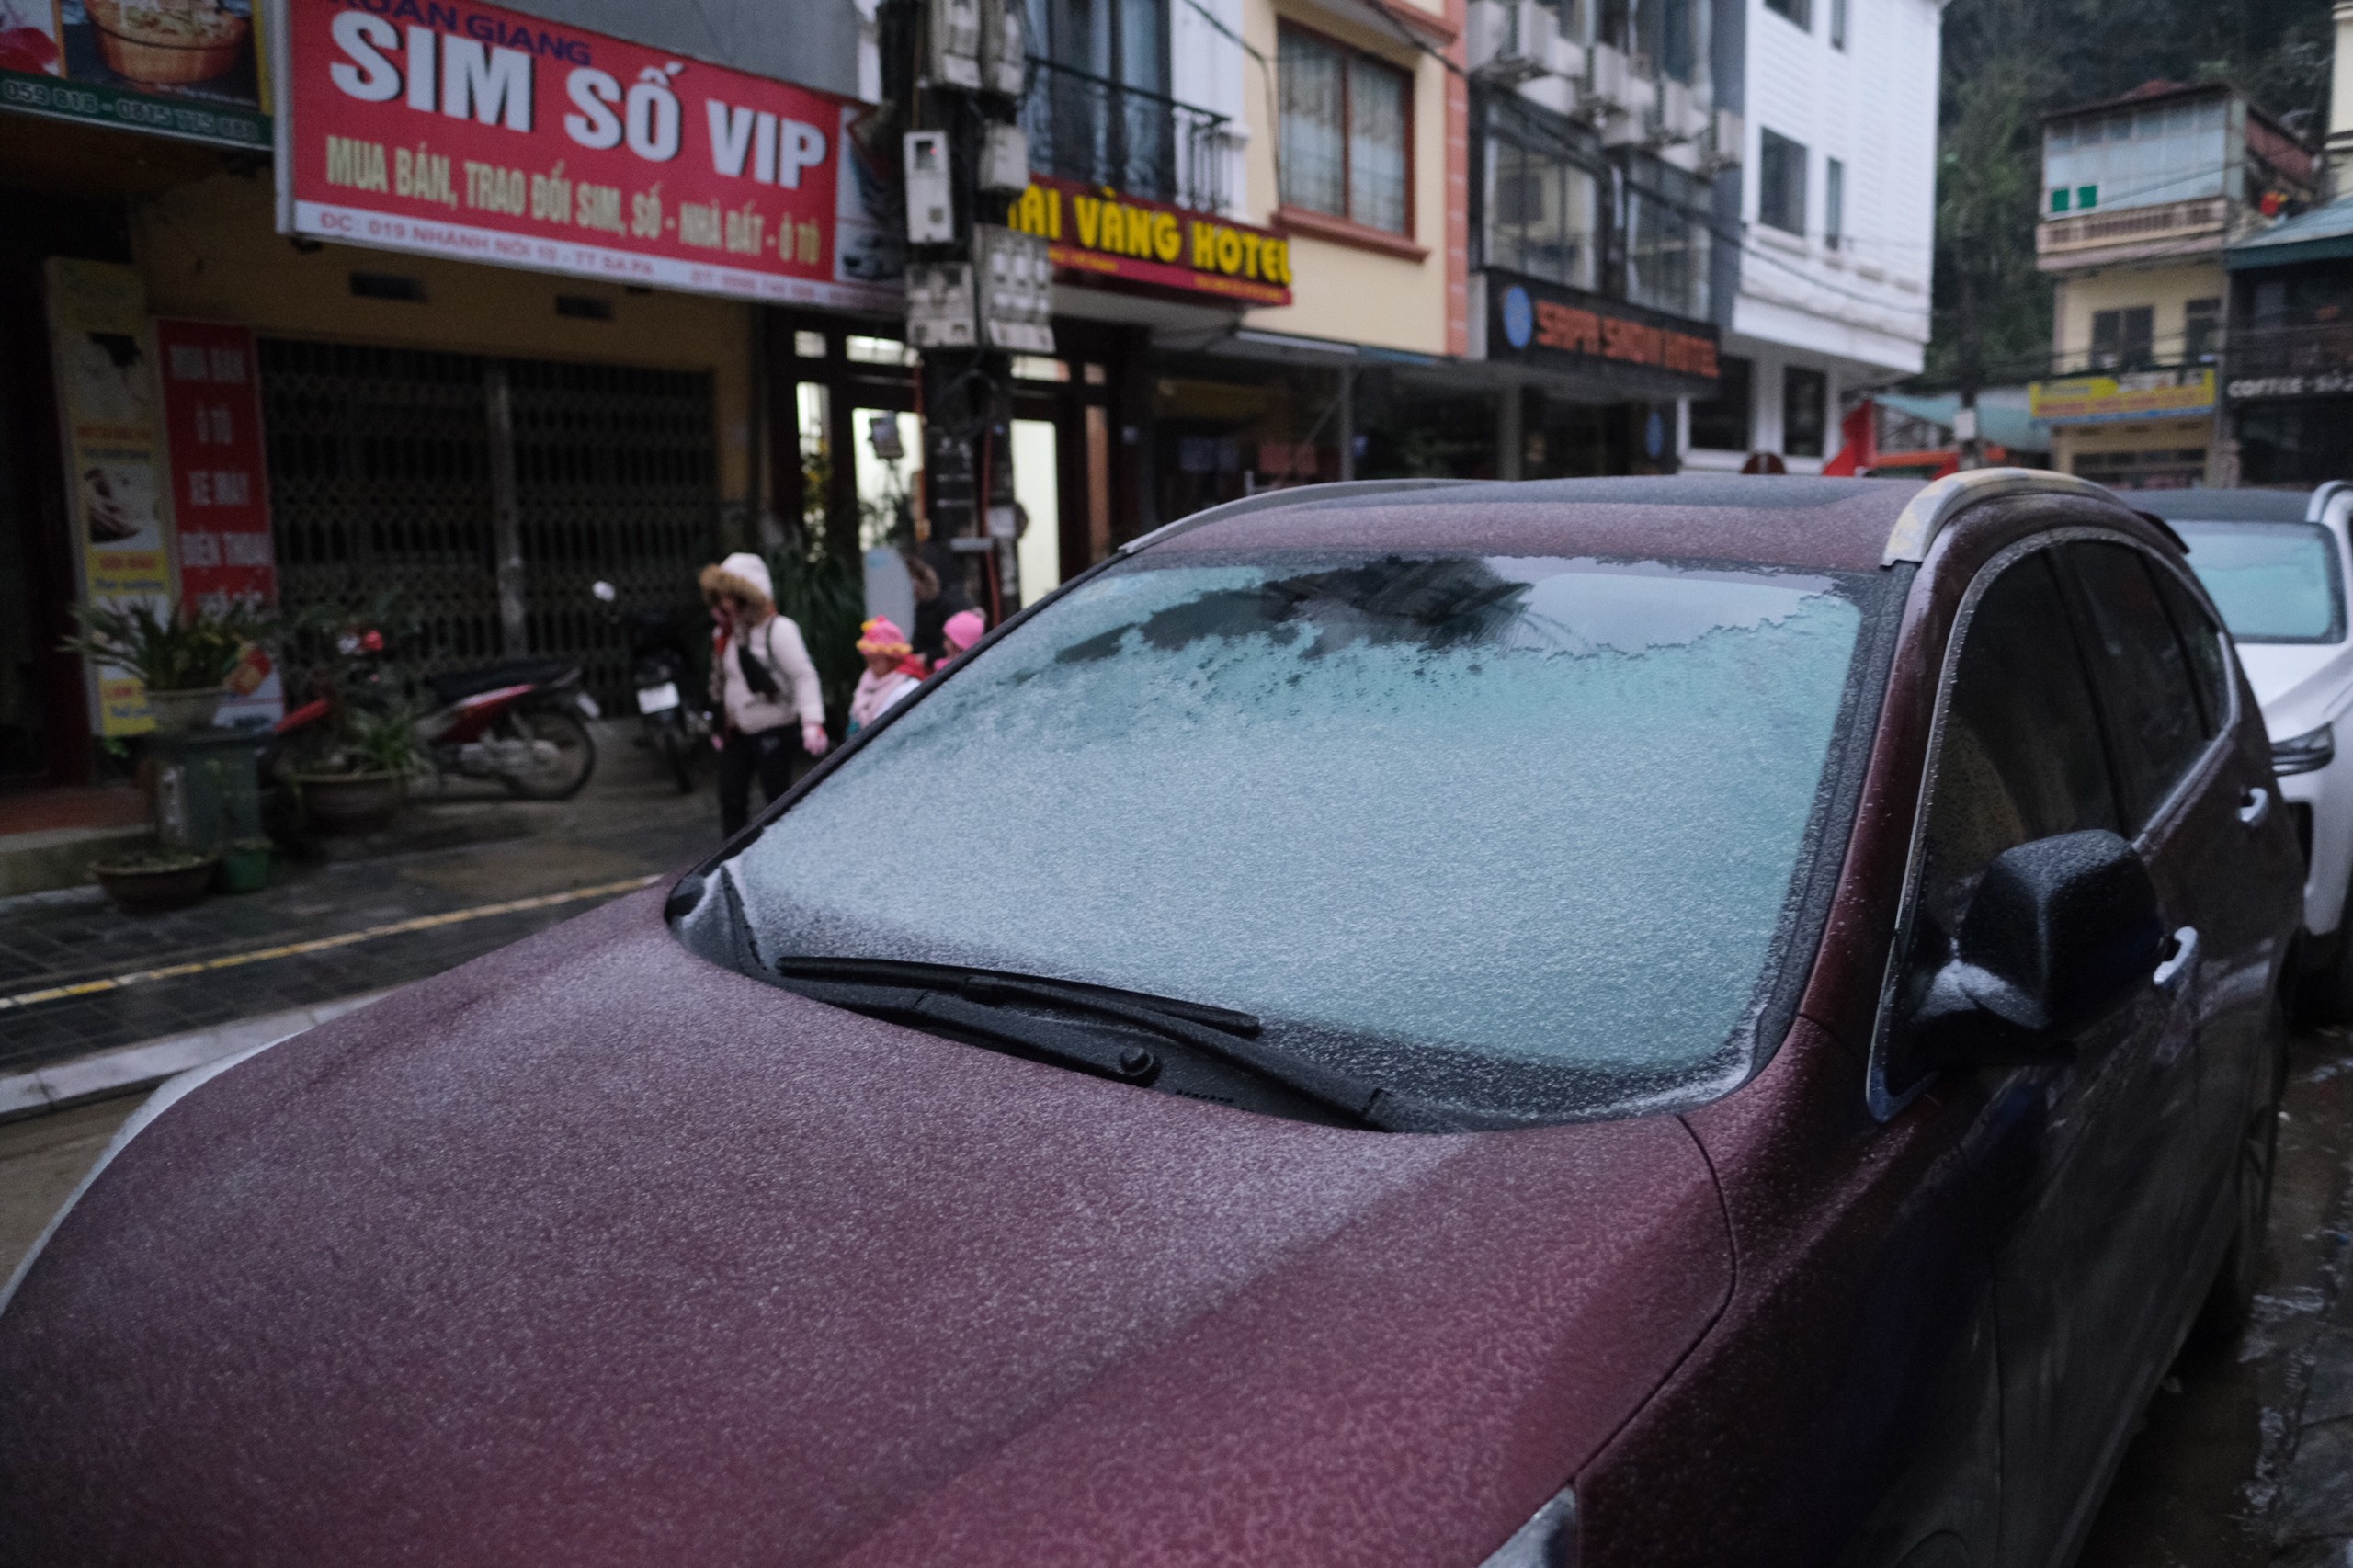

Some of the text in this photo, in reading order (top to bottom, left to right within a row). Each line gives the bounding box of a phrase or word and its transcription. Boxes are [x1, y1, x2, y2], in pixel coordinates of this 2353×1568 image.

[466, 14, 592, 67] GIANG
[330, 10, 827, 189] SIM SỐ VIP
[326, 134, 389, 193] MUA
[394, 141, 458, 210] BÁN,
[464, 160, 526, 217] TRAO
[1074, 187, 1183, 264] VÀNG
[1191, 220, 1294, 287] HOTEL
